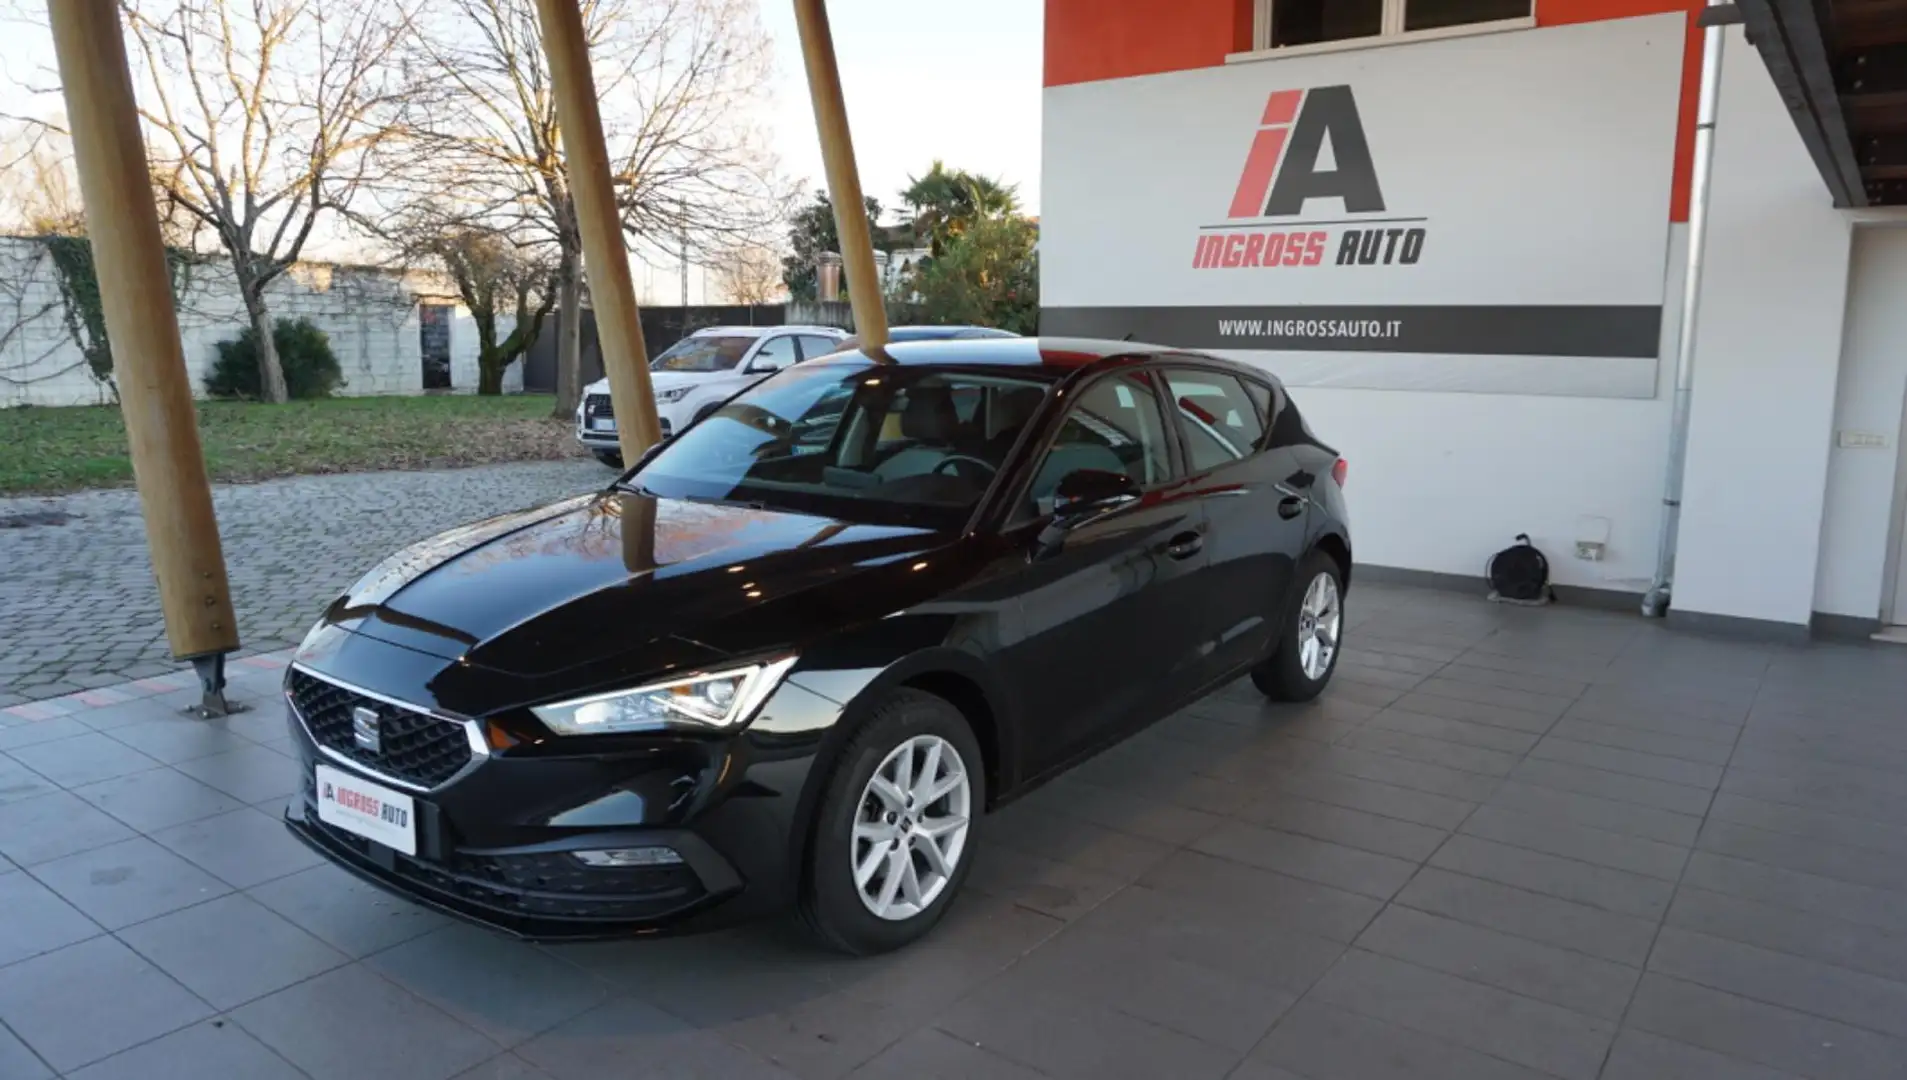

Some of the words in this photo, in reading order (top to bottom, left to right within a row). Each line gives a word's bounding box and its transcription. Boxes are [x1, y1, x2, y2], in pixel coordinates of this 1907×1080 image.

[1192, 232, 1327, 269] INGROSS
[1336, 228, 1426, 266] AUTO
[1218, 319, 1402, 338] WWW.INGROSSAUTO.IT
[336, 787, 380, 818] INGROSS
[381, 802, 409, 829] AUTO
